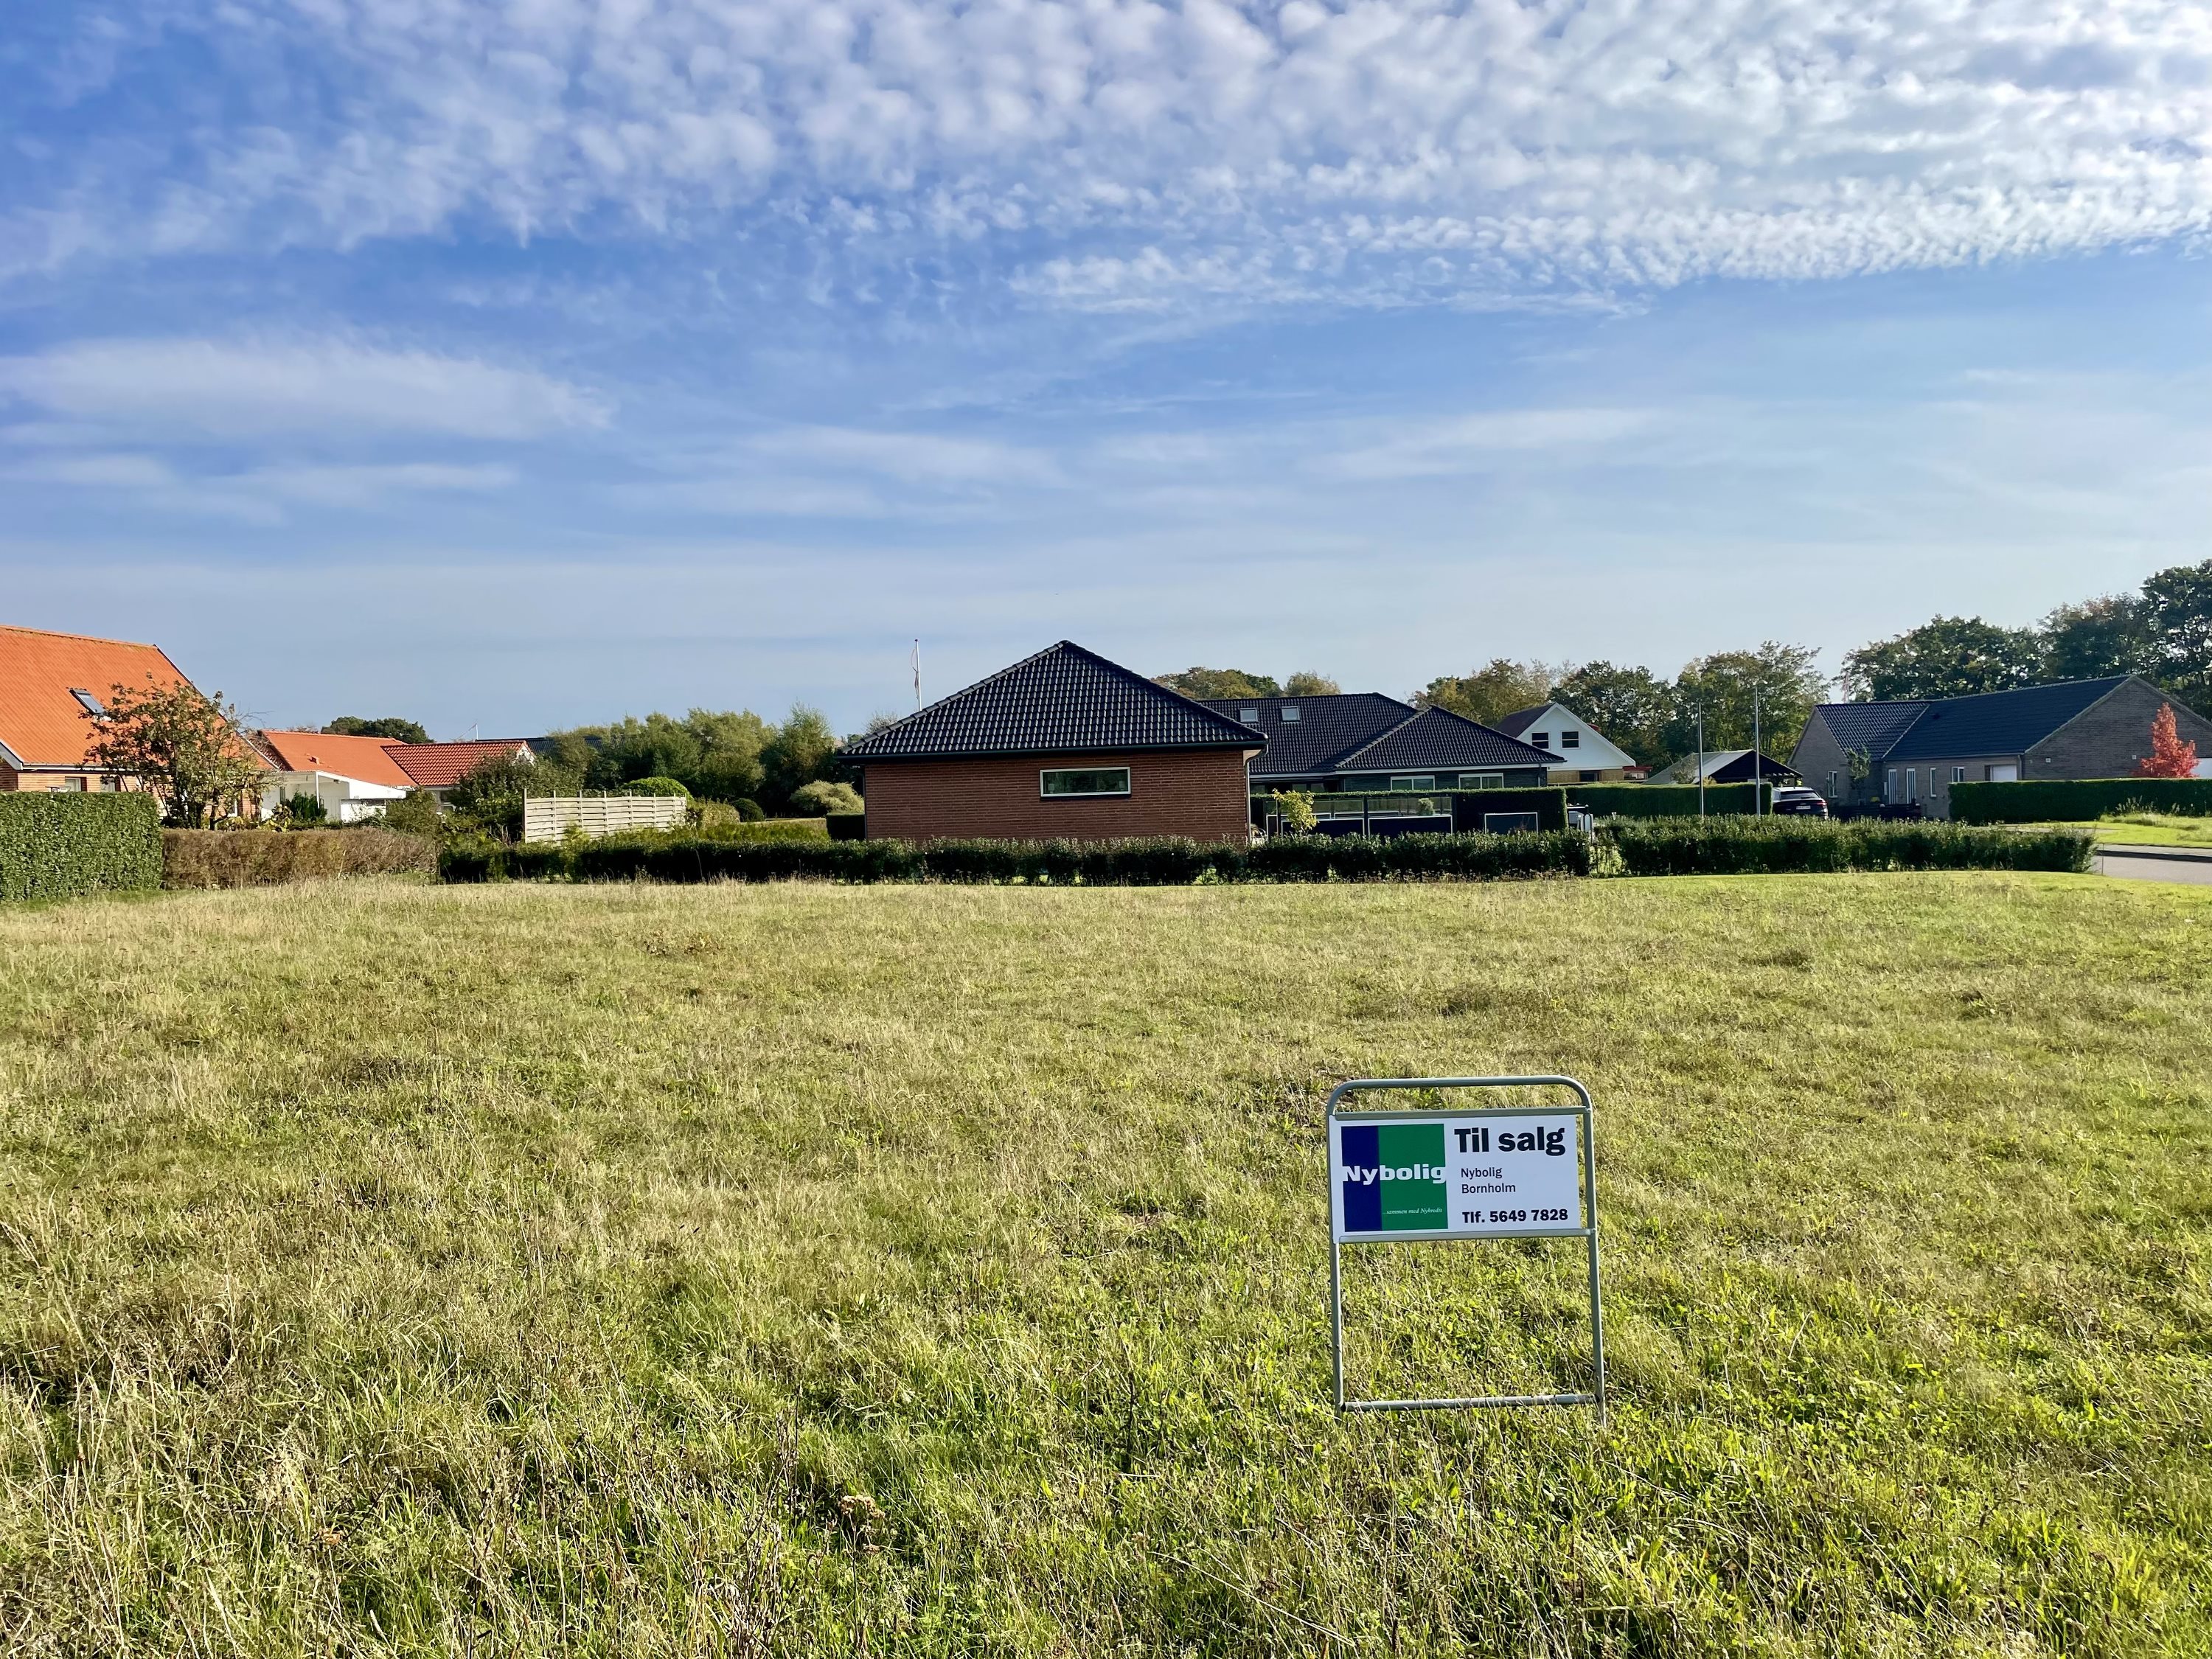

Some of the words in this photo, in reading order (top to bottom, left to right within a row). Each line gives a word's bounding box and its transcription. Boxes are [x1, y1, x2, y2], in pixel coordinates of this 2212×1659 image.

[1454, 1127, 1489, 1152] Til
[1498, 1126, 1565, 1156] salg
[1342, 1164, 1446, 1185] Nybolig
[1461, 1167, 1503, 1179] Nybolig
[1461, 1183, 1516, 1194] Bornholm
[1462, 1211, 1485, 1223] Tlf.
[1489, 1210, 1527, 1222] 5649
[1531, 1208, 1568, 1221] 7828
